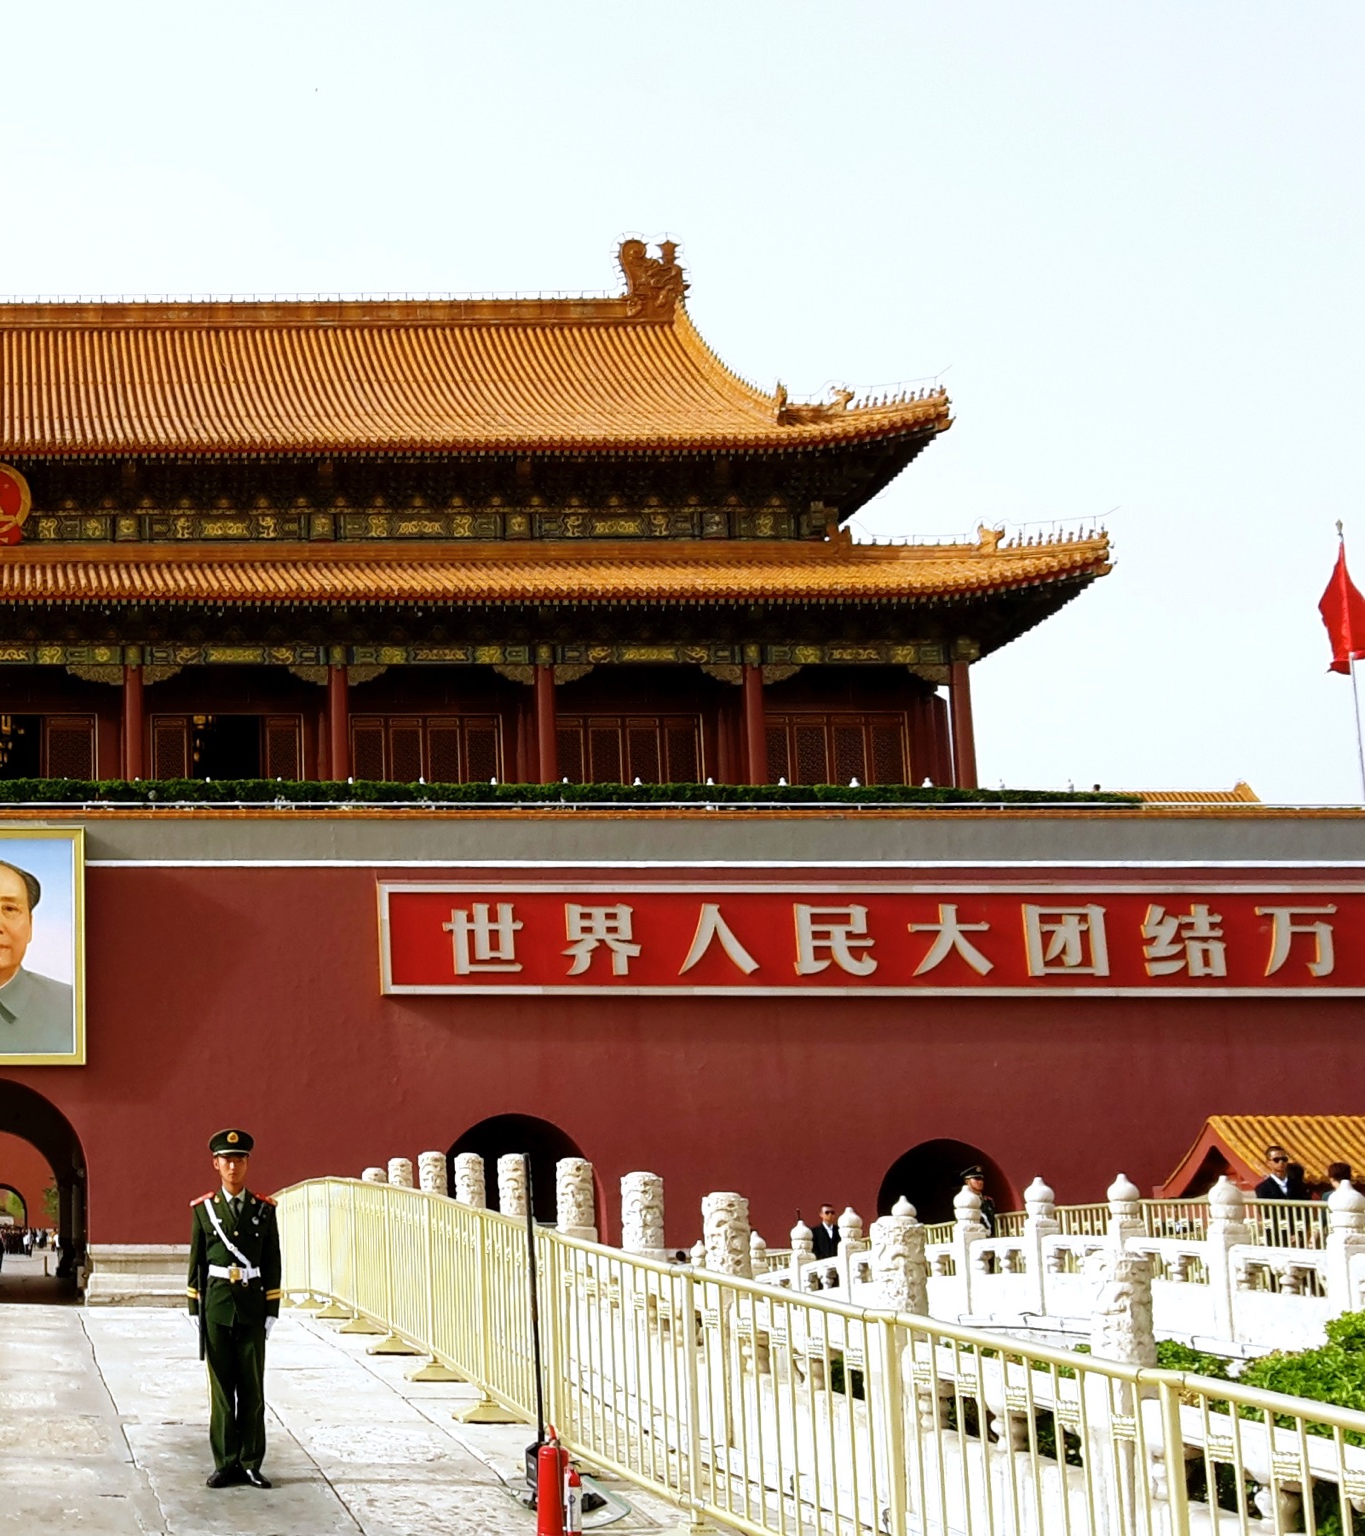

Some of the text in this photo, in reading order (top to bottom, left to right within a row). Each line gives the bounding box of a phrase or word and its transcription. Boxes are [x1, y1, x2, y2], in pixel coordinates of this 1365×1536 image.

[442, 903, 1338, 976] 世界人民大团结万
